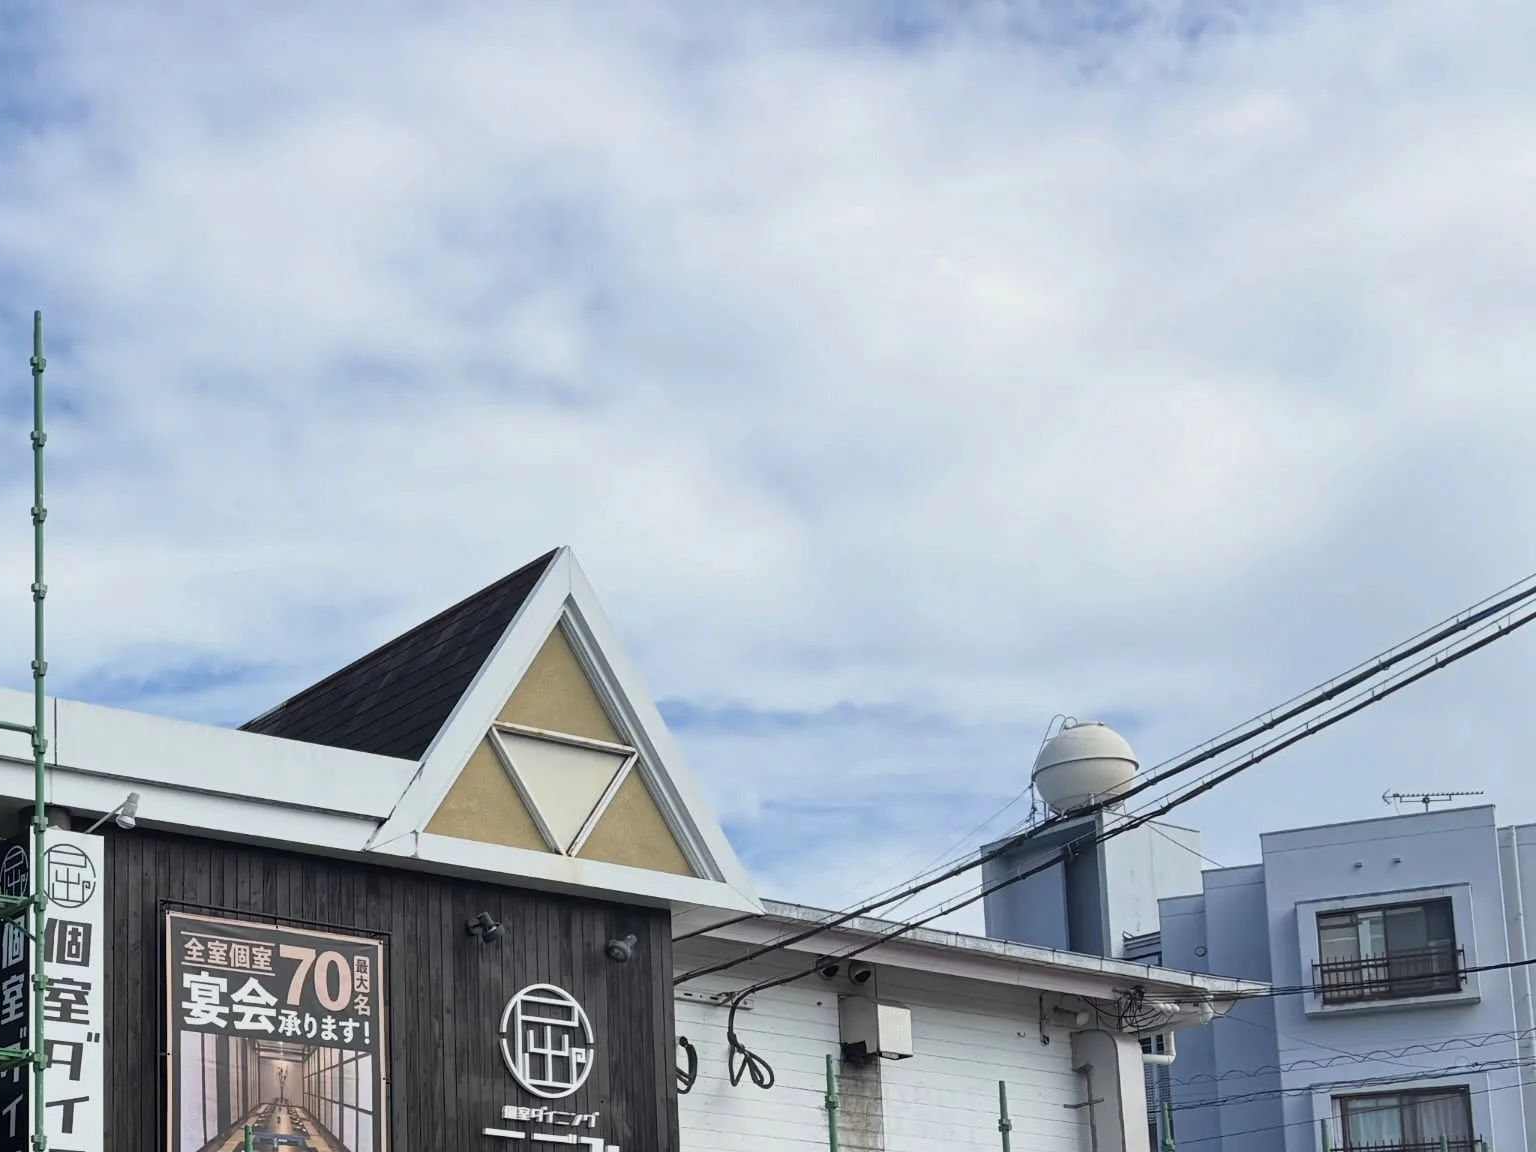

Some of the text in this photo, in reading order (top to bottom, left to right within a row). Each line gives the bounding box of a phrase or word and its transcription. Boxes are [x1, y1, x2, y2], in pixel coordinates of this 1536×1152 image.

[184, 937, 273, 971] 全室個室
[279, 944, 352, 1012] 70
[502, 1105, 600, 1128] 個室ダイニング
